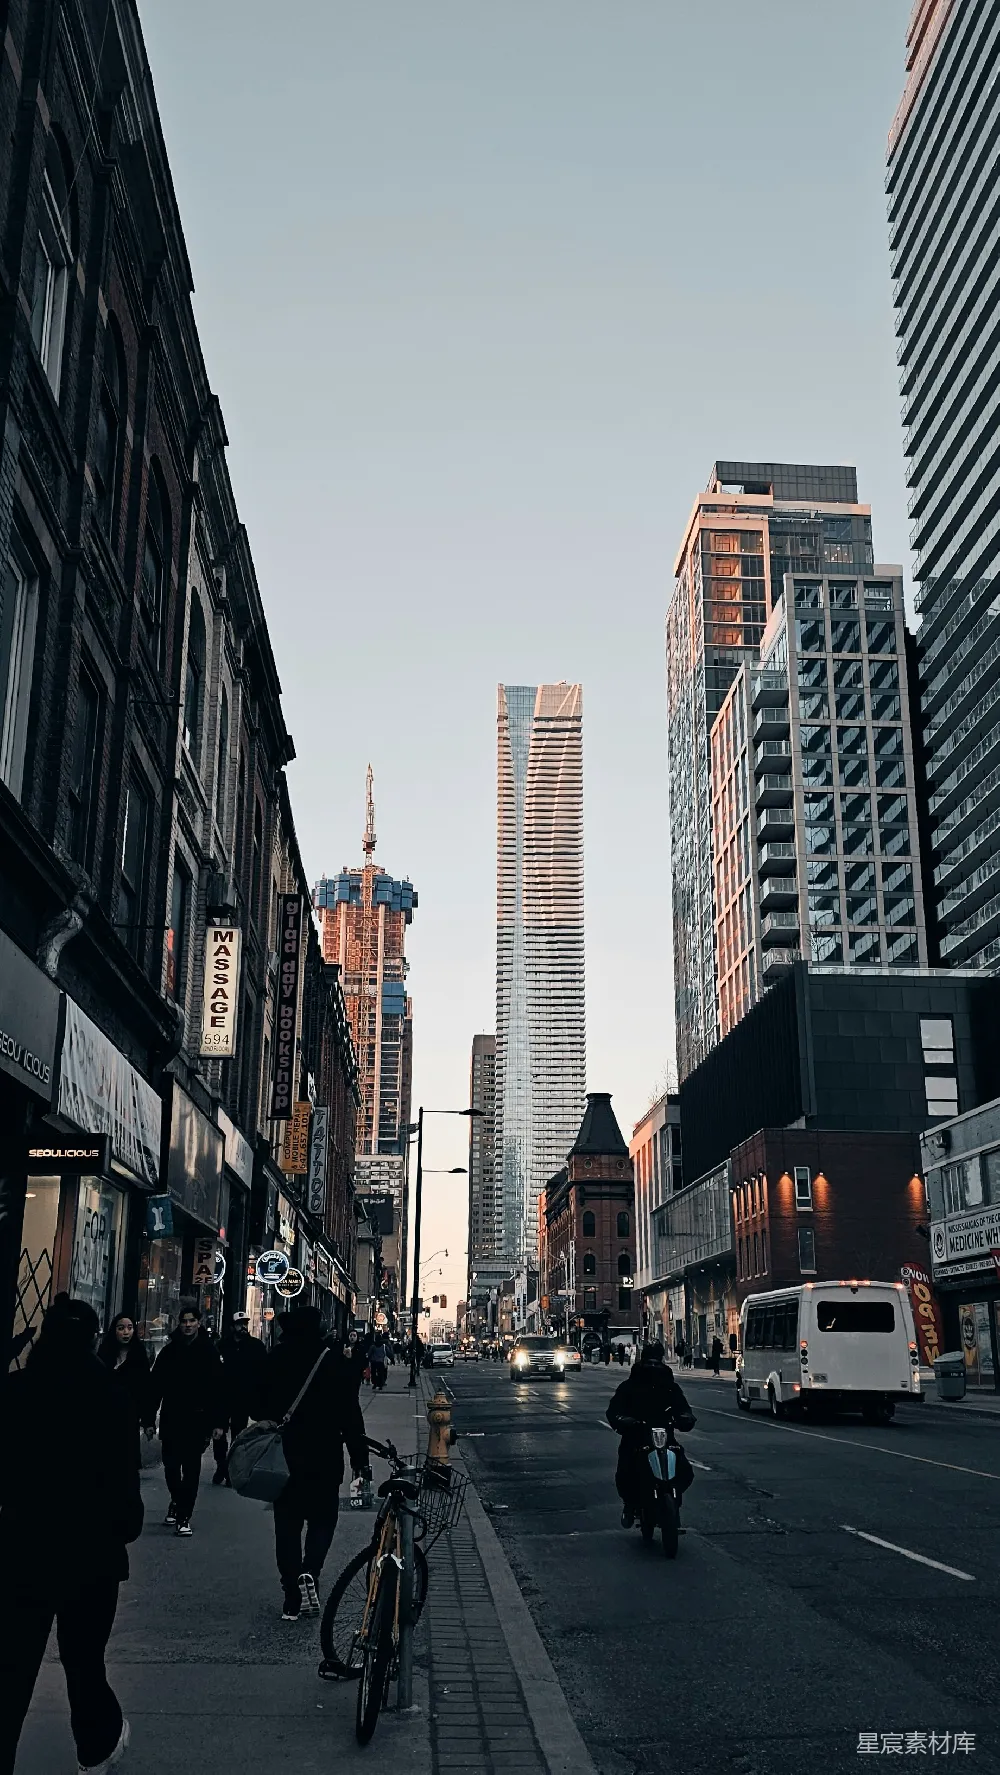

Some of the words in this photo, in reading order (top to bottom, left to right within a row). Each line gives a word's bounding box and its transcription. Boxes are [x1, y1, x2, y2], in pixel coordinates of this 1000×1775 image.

[285, 901, 298, 953] glad
[210, 930, 234, 1028] MASSAGE
[282, 960, 296, 998] day
[204, 1033, 230, 1045] 594
[275, 1004, 293, 1110] bookshop
[28, 1149, 99, 1157] SEOULICIOUS
[284, 1119, 293, 1160] COMPUTE
[310, 1108, 326, 1212] TATTOO
[980, 1217, 986, 1227] OF
[986, 1214, 995, 1224] THE
[195, 1240, 213, 1276] SPA
[949, 1230, 984, 1253] MEDICINE
[195, 1276, 213, 1284] 2F
